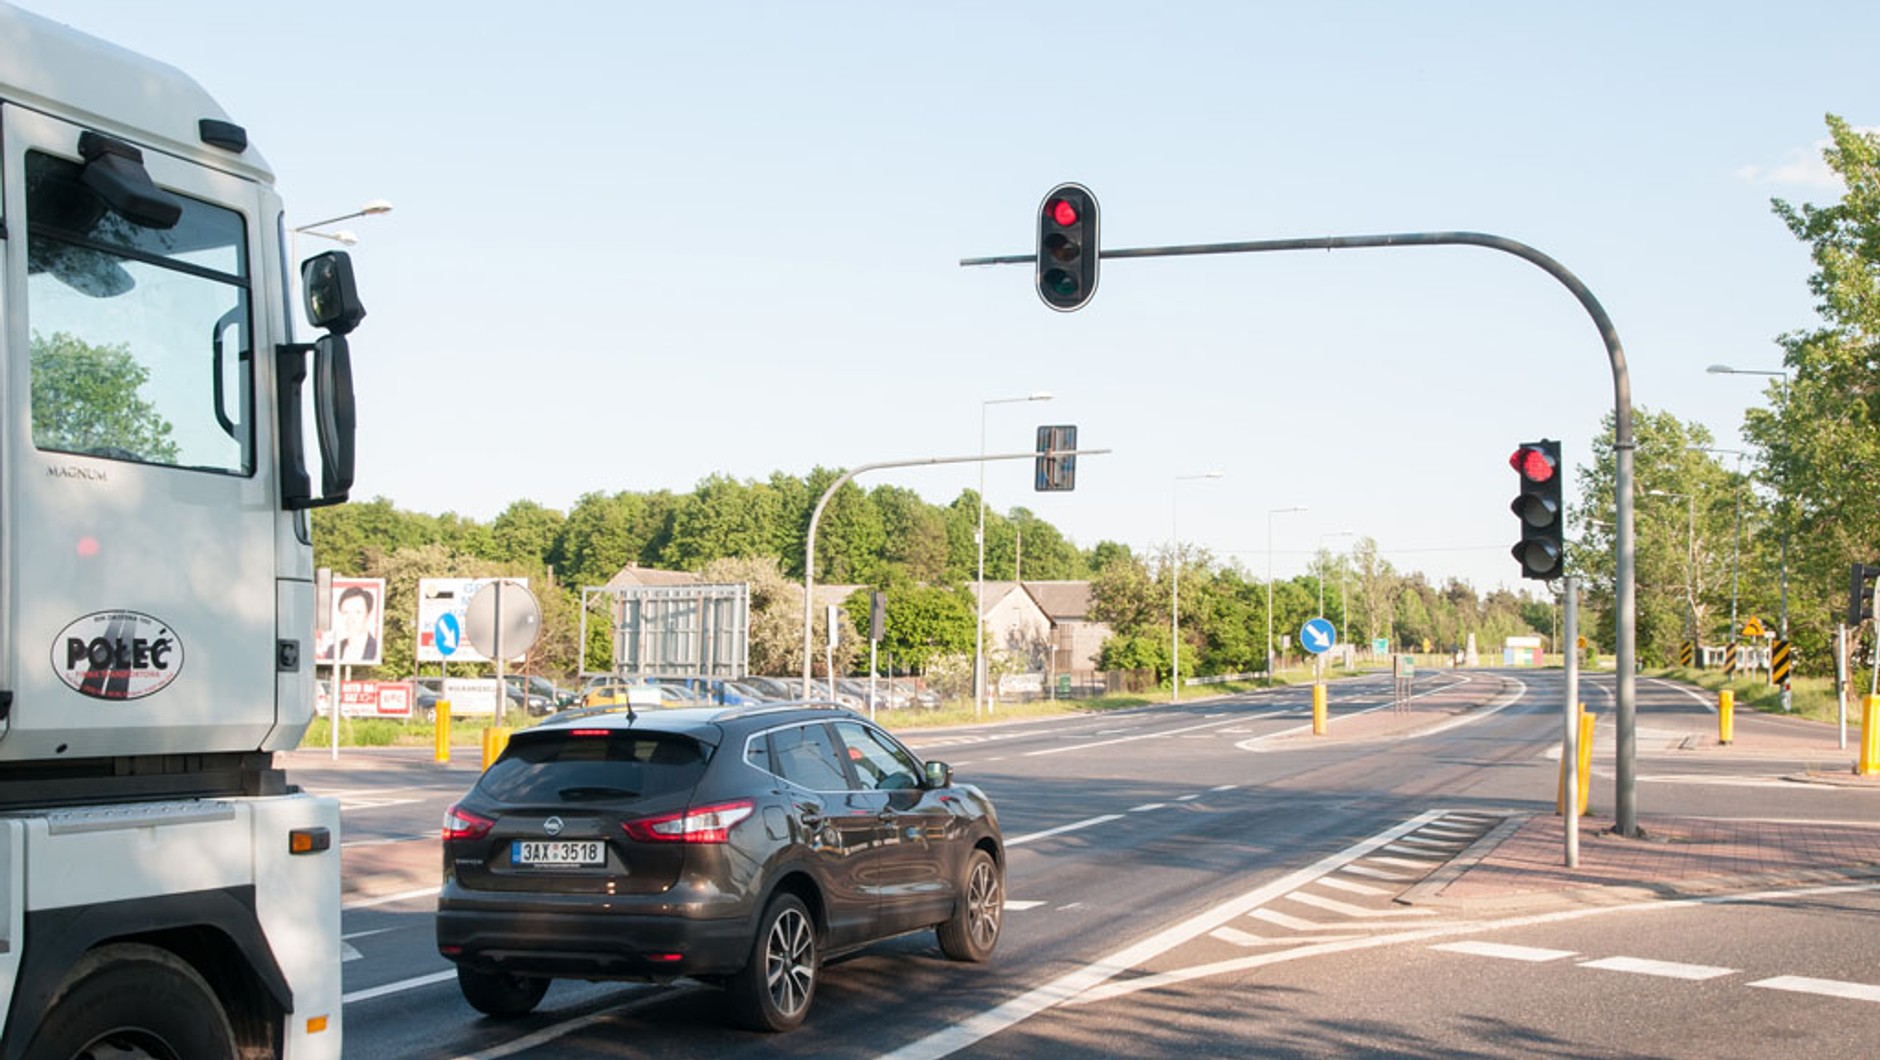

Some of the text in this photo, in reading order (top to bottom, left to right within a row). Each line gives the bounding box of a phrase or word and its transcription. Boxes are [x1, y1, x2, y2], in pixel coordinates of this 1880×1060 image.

[46, 463, 108, 482] MAGNUM
[66, 628, 173, 670] POŁEĆ
[524, 844, 598, 860] 3AX 3518
